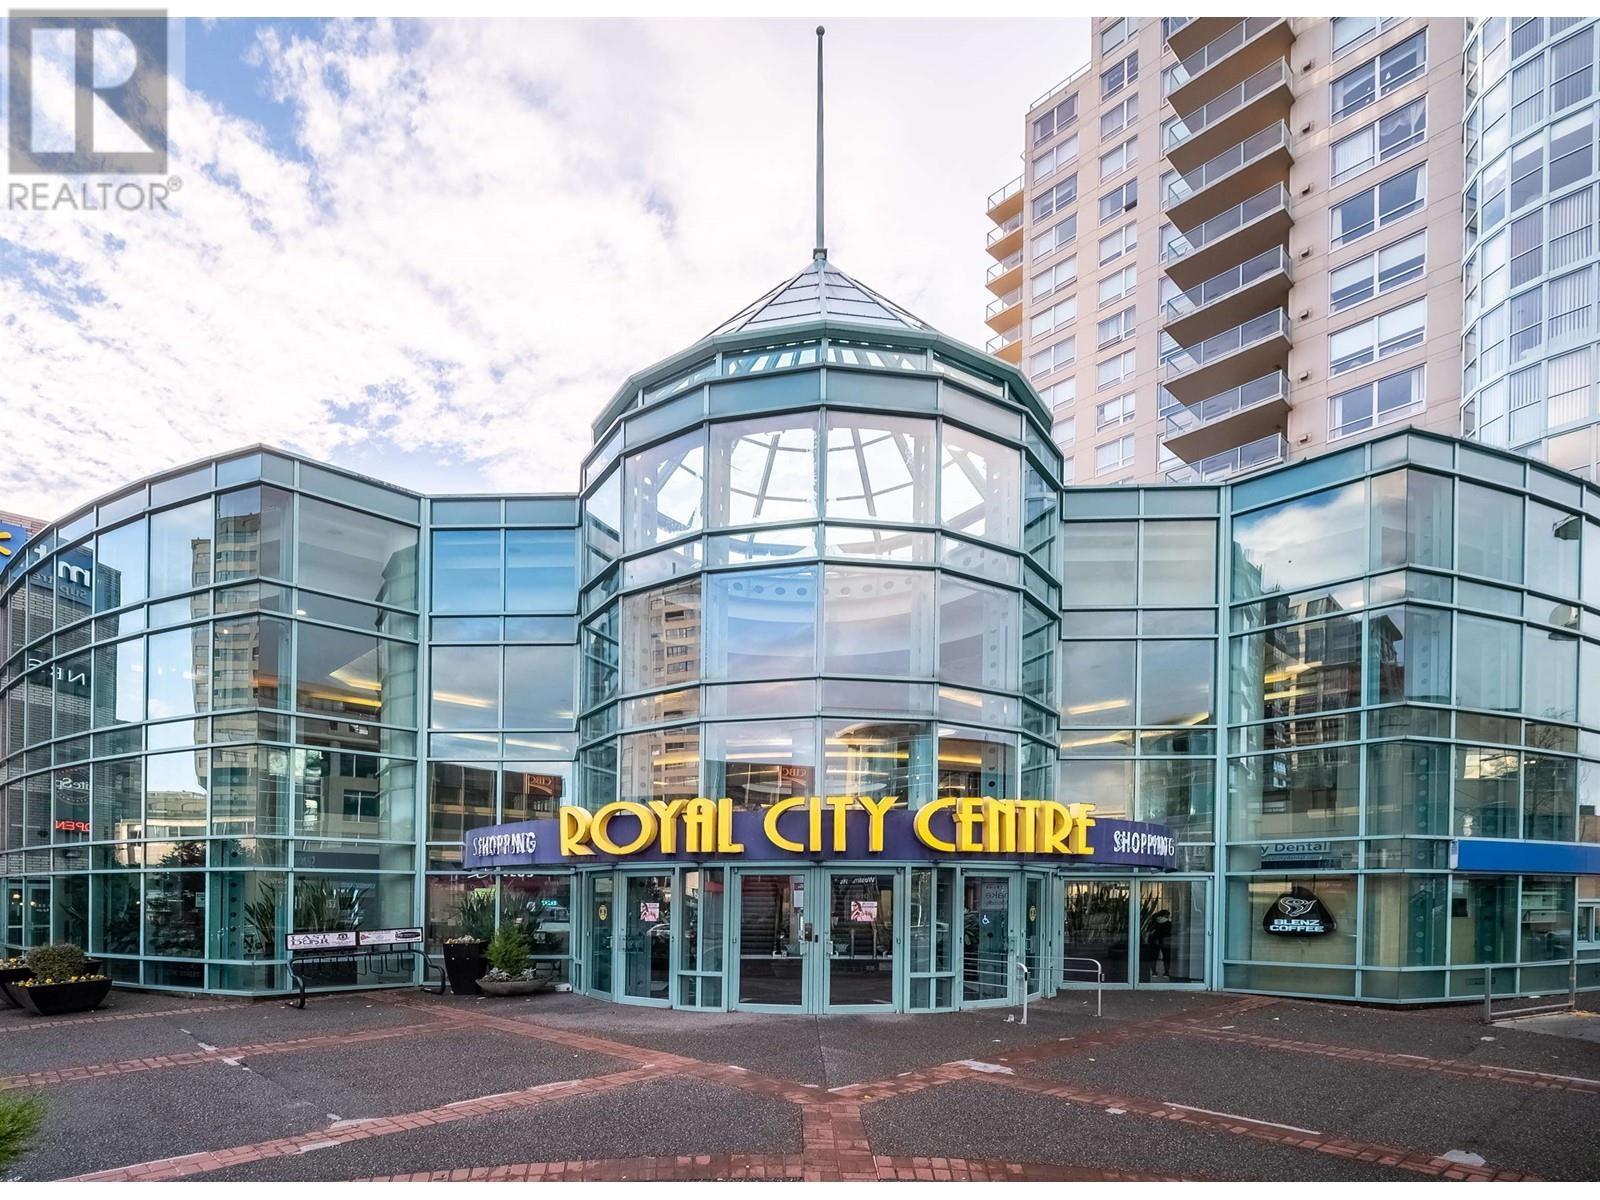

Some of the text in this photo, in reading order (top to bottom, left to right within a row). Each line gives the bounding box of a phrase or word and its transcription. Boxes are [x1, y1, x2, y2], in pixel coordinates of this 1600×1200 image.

[472, 795, 1175, 857] SHOPPING ROYAL CITY CENTRE SHOPPING
[1274, 841, 1328, 853] Dental
[1269, 925, 1325, 933] COFFEE
